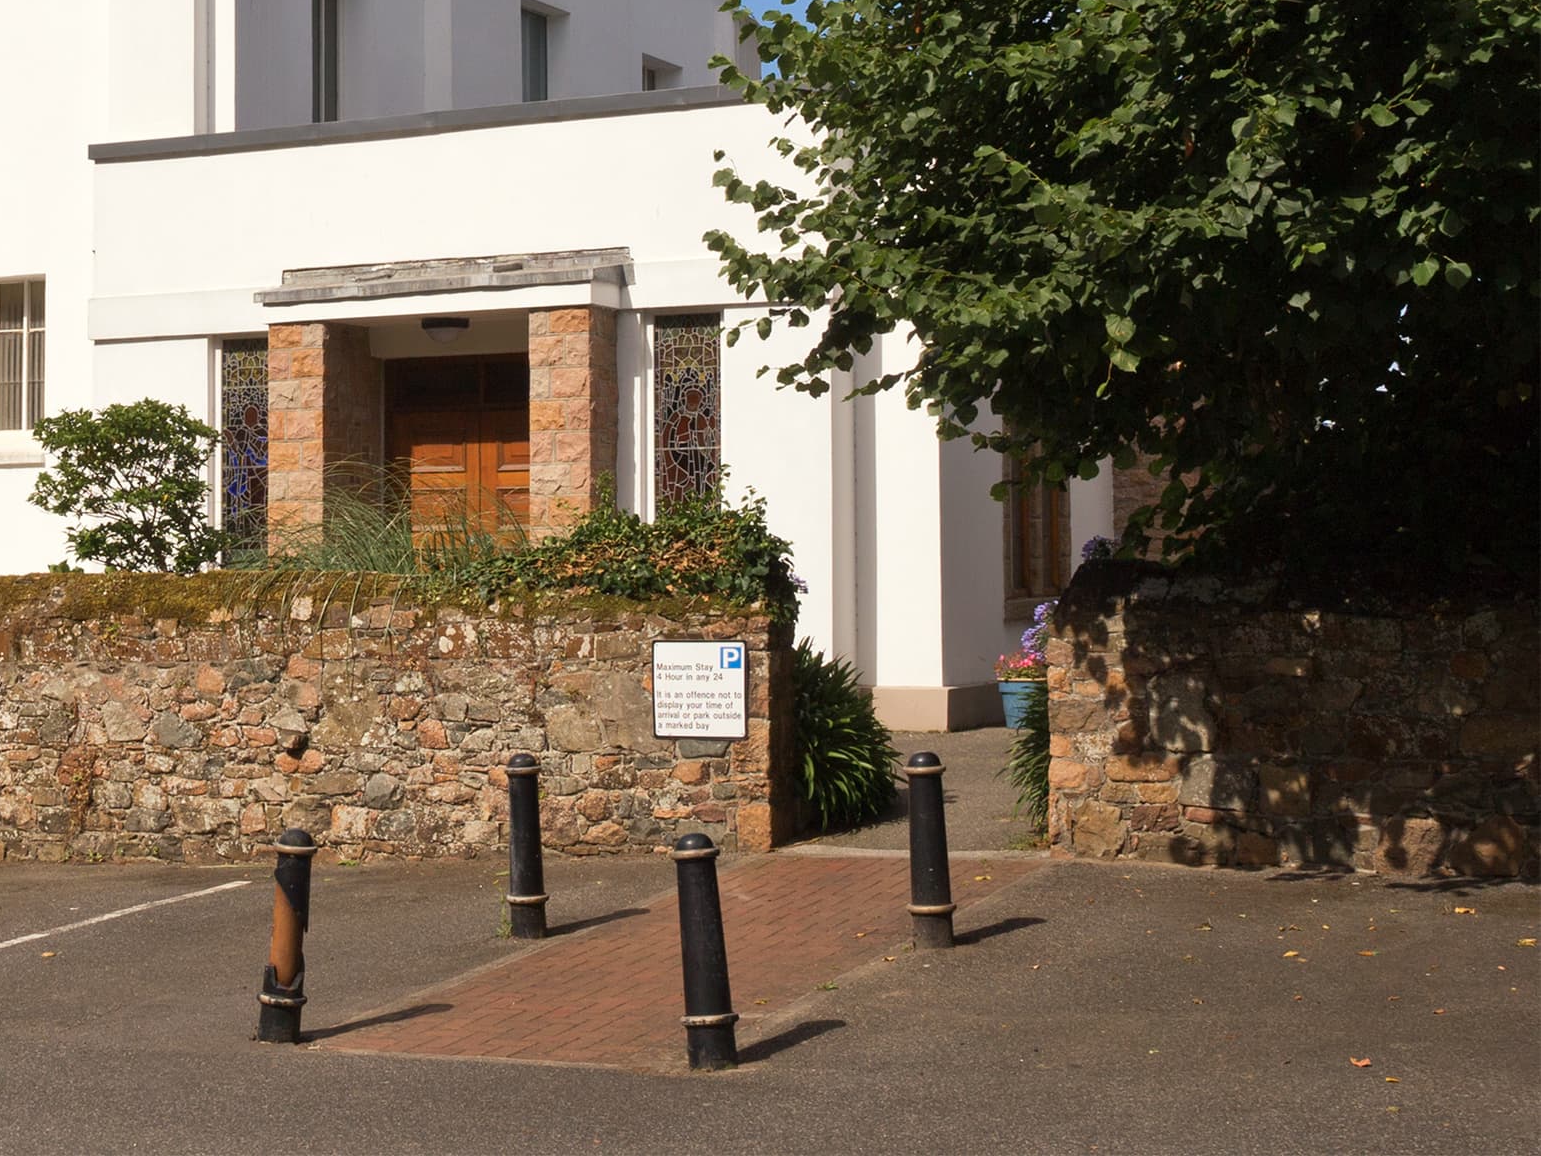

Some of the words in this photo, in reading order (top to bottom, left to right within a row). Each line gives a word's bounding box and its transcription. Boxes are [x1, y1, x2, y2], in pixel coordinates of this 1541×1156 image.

[695, 663, 714, 672] Stay
[657, 701, 683, 709] display
[696, 722, 710, 730] bay
